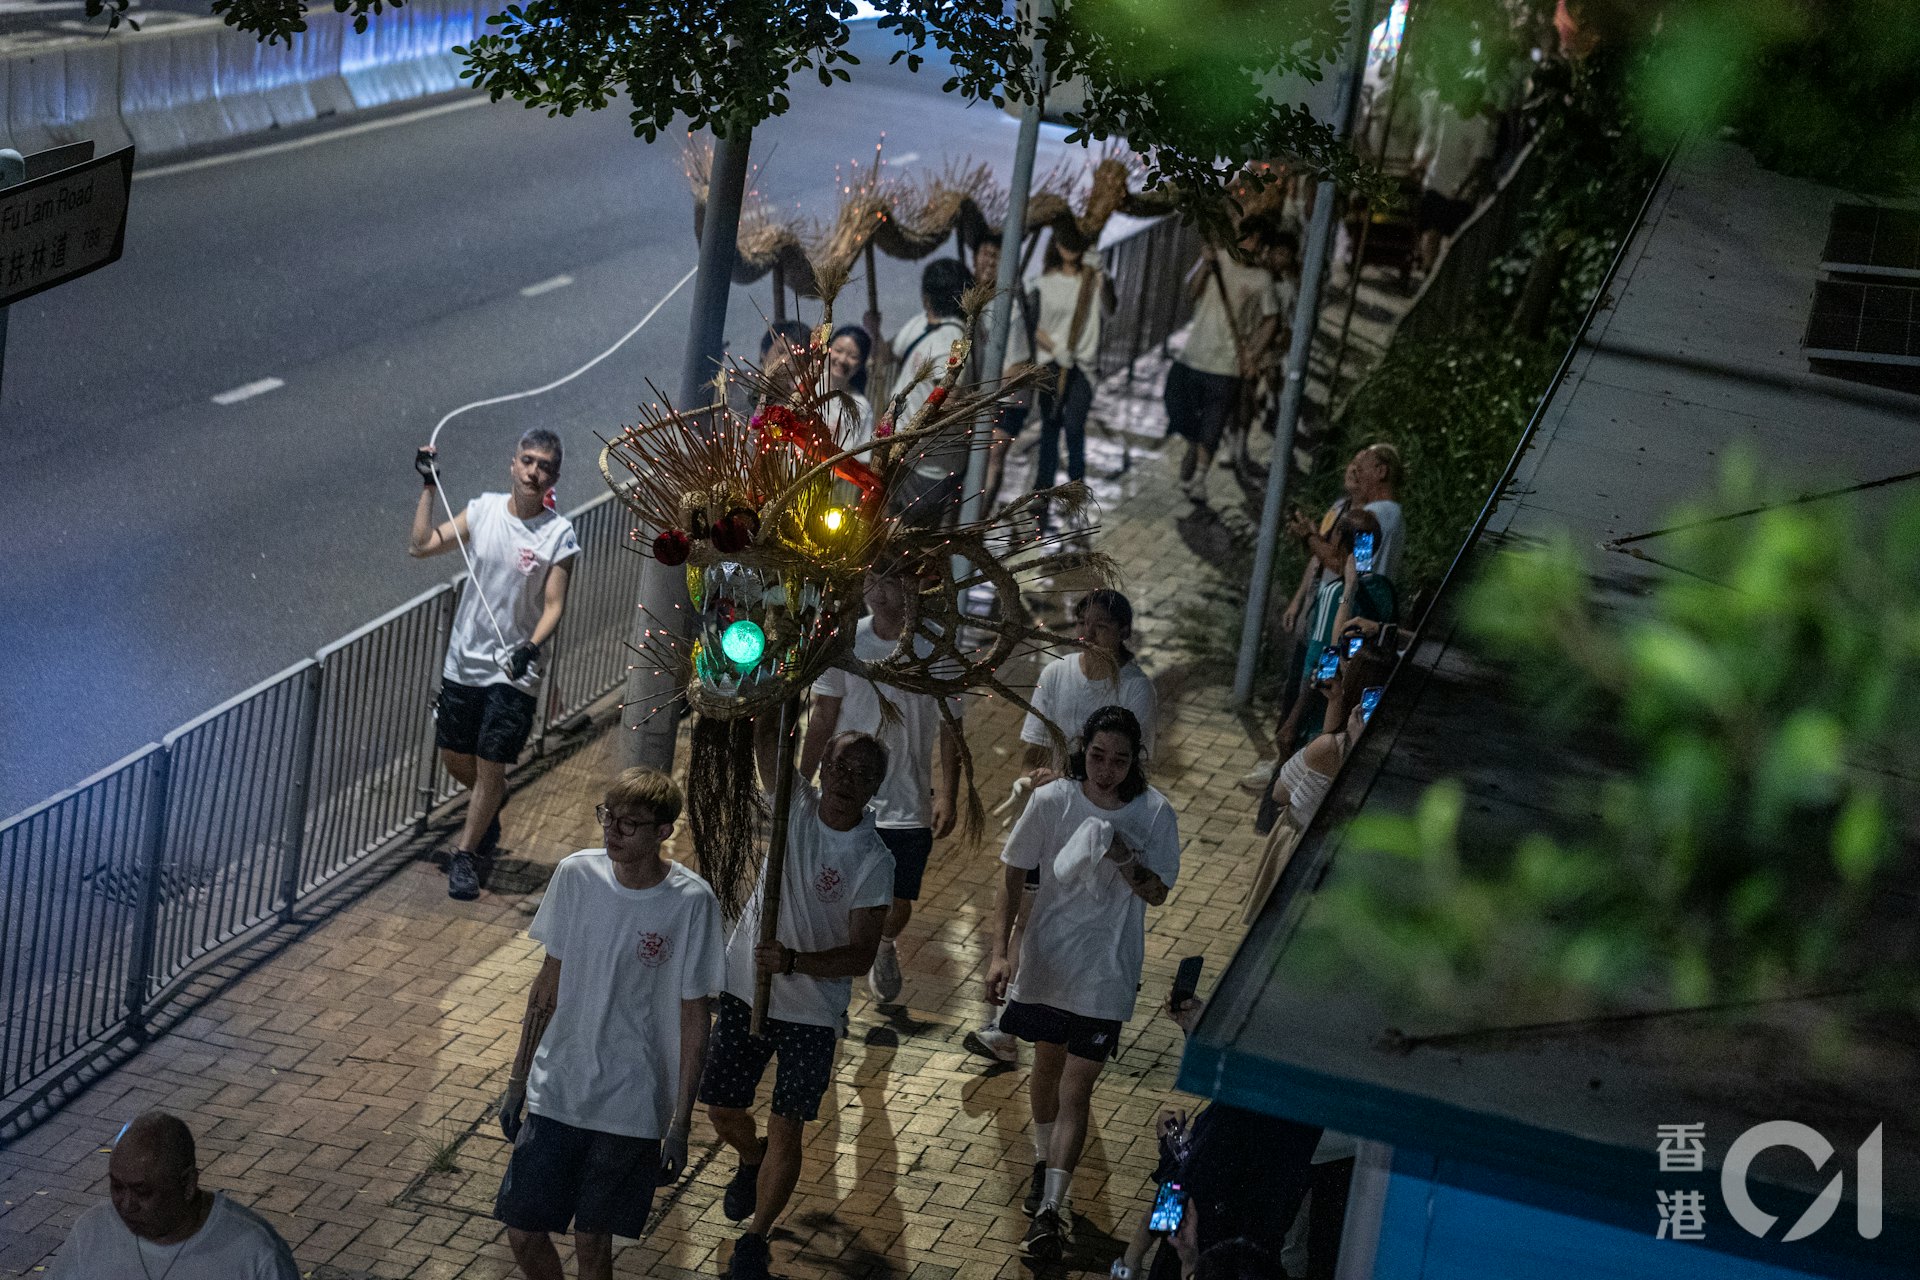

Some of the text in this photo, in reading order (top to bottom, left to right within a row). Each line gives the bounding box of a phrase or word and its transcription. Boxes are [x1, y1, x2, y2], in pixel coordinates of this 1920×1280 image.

[1, 177, 93, 233] Fu Lam Road
[0, 230, 67, 287] 扶林道
